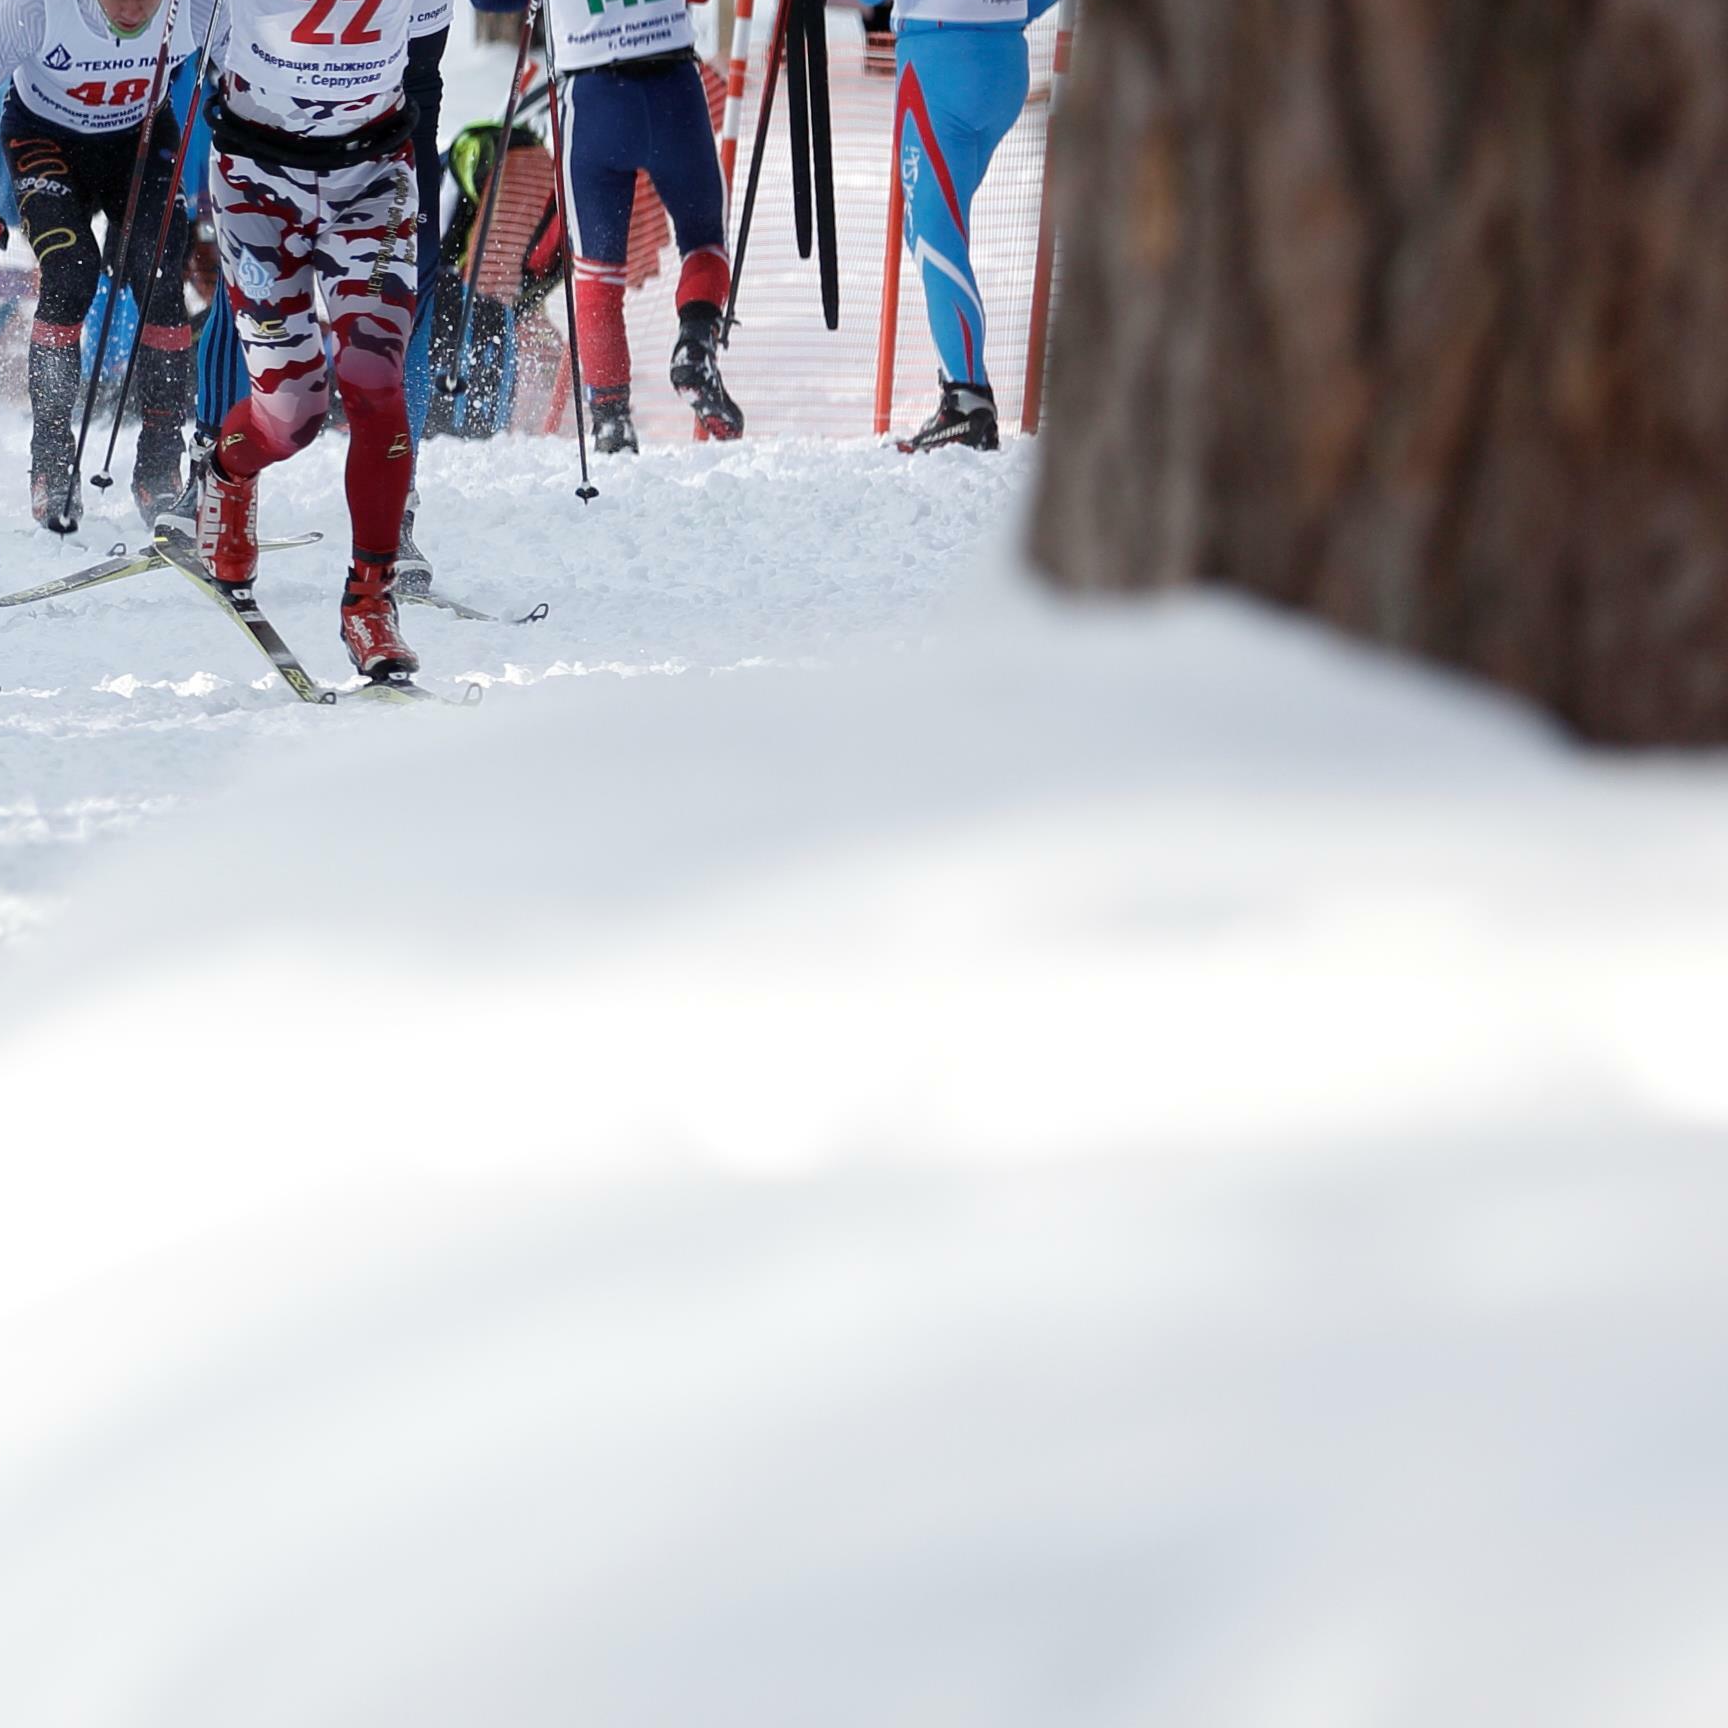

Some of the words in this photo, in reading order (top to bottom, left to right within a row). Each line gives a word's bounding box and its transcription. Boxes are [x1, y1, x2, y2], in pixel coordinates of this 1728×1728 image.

[323, 57, 386, 73] лыжного
[295, 75, 308, 85] г.
[311, 72, 382, 89] Серпухова
[65, 77, 151, 107] 48
